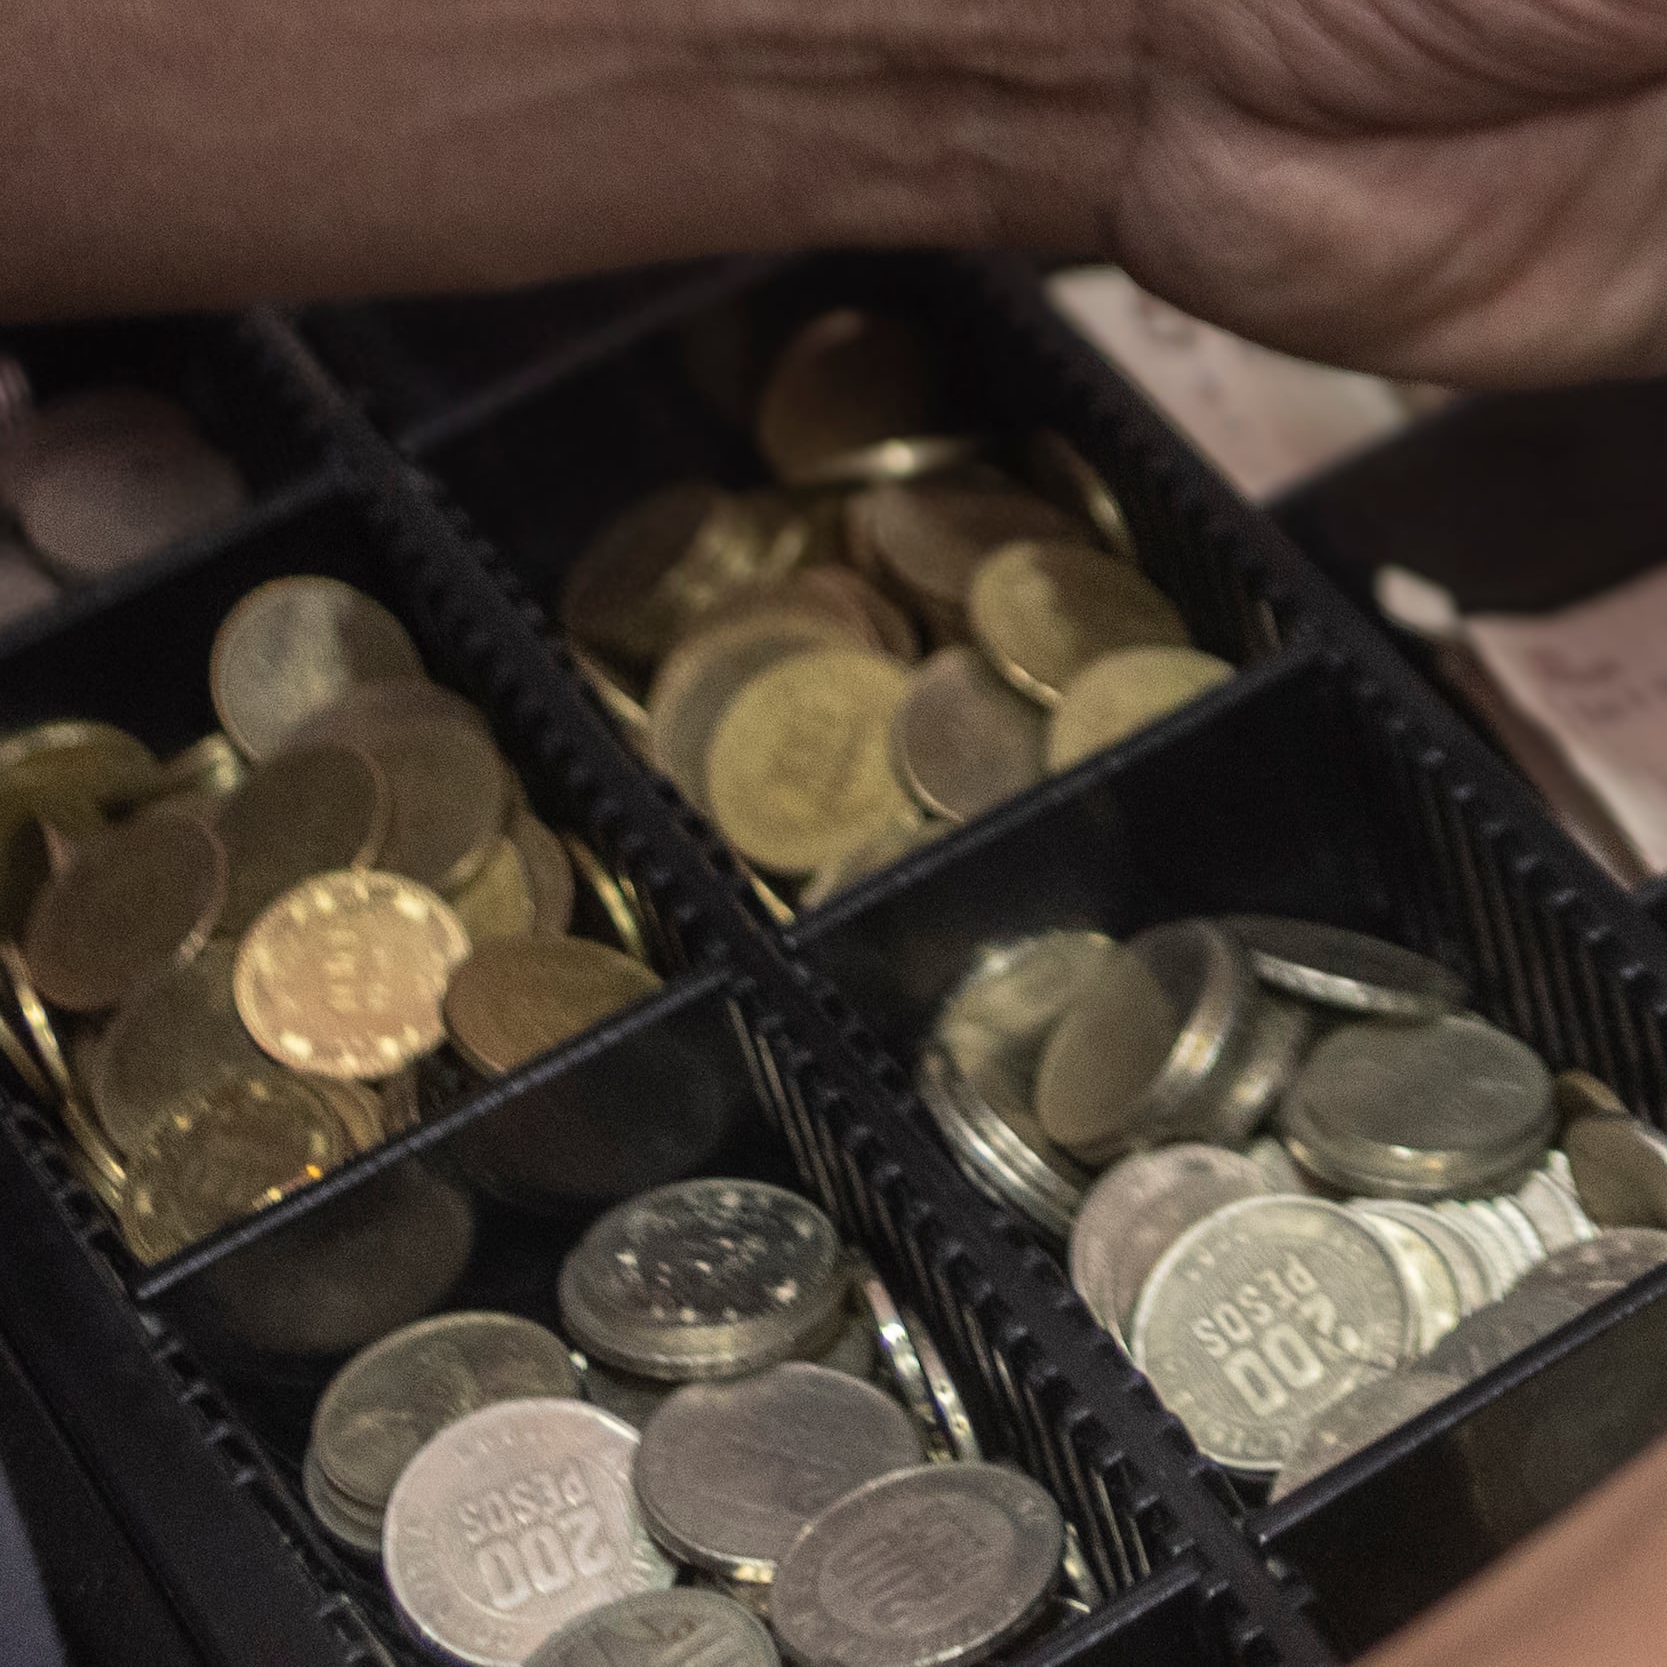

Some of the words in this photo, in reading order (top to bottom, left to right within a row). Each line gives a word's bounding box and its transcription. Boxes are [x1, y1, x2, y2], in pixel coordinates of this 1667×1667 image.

[1190, 1254, 1318, 1358] PESOS
[458, 1455, 589, 1543] PESOS
[477, 1504, 611, 1609] 200
